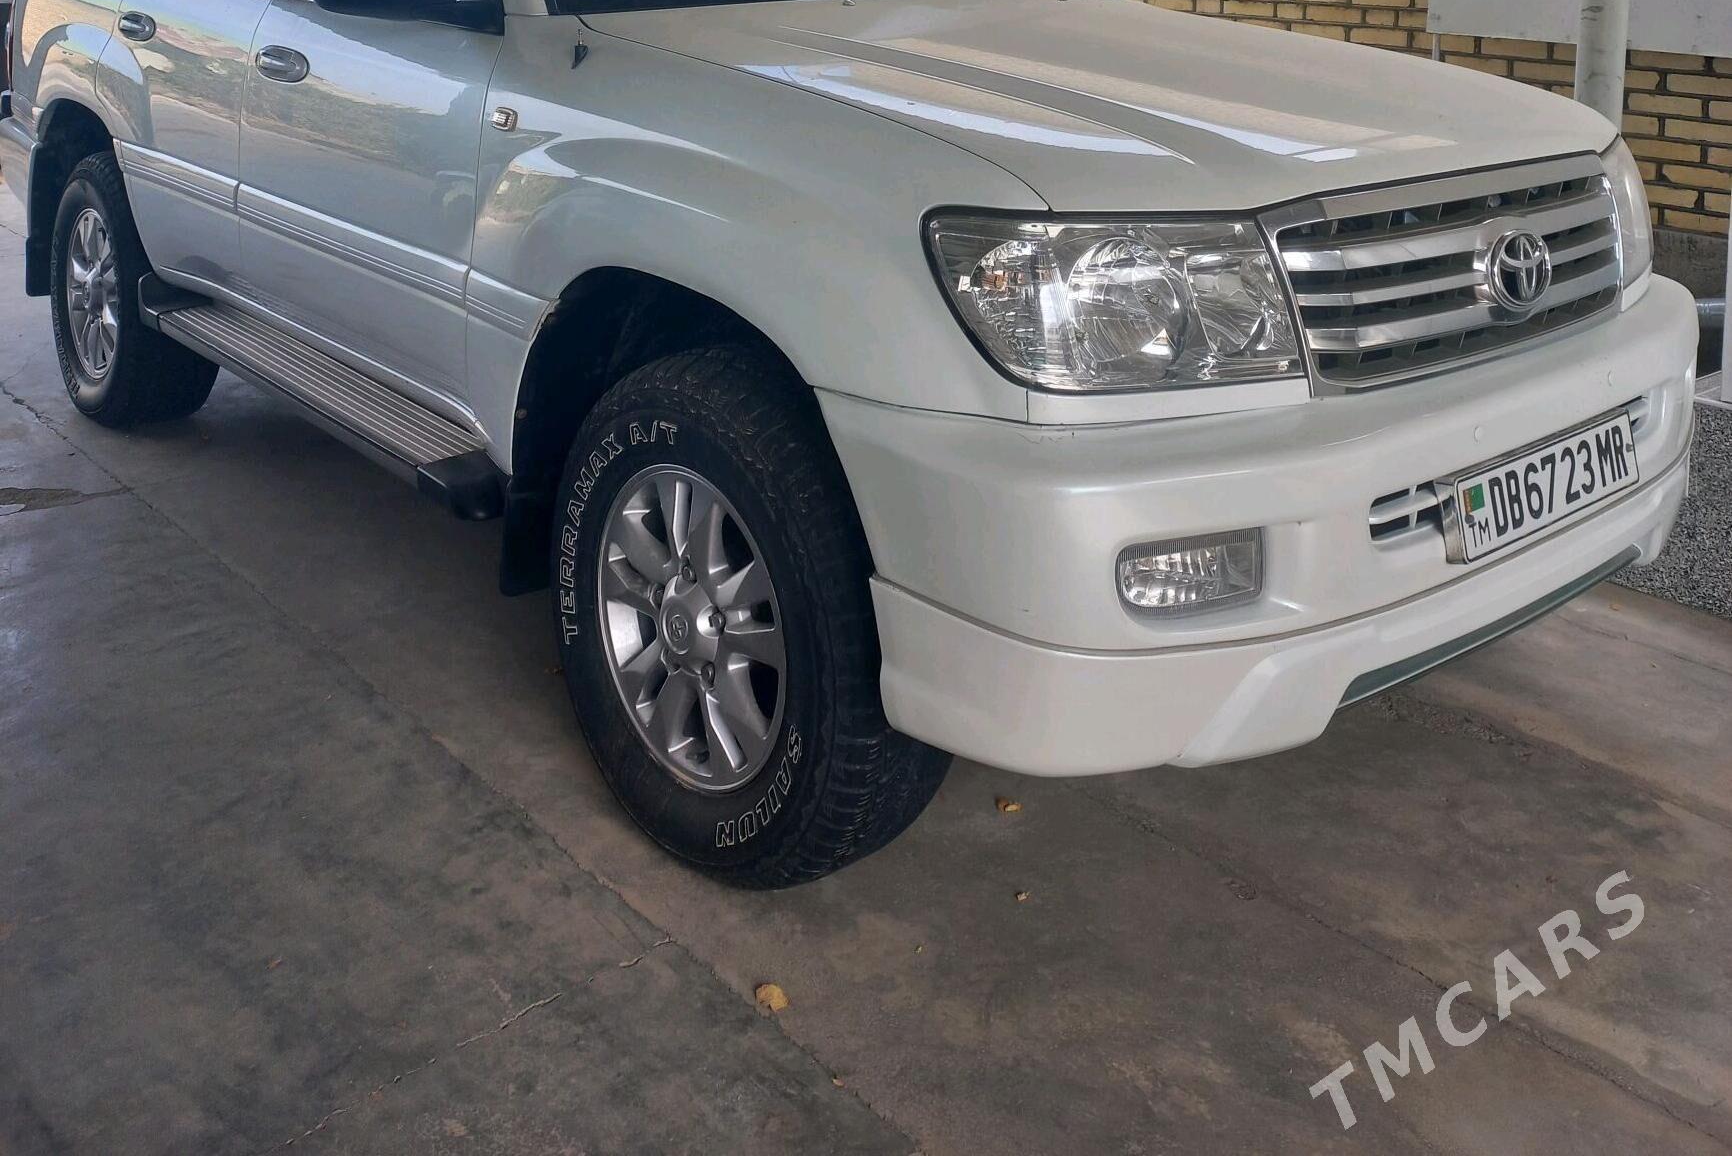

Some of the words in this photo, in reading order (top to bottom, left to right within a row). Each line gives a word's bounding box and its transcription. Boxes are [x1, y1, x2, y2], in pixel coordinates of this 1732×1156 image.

[560, 433, 624, 645] TERRAMAX
[629, 420, 678, 445] A/T
[1468, 518, 1492, 548] TM
[715, 724, 802, 848] SAILUN
